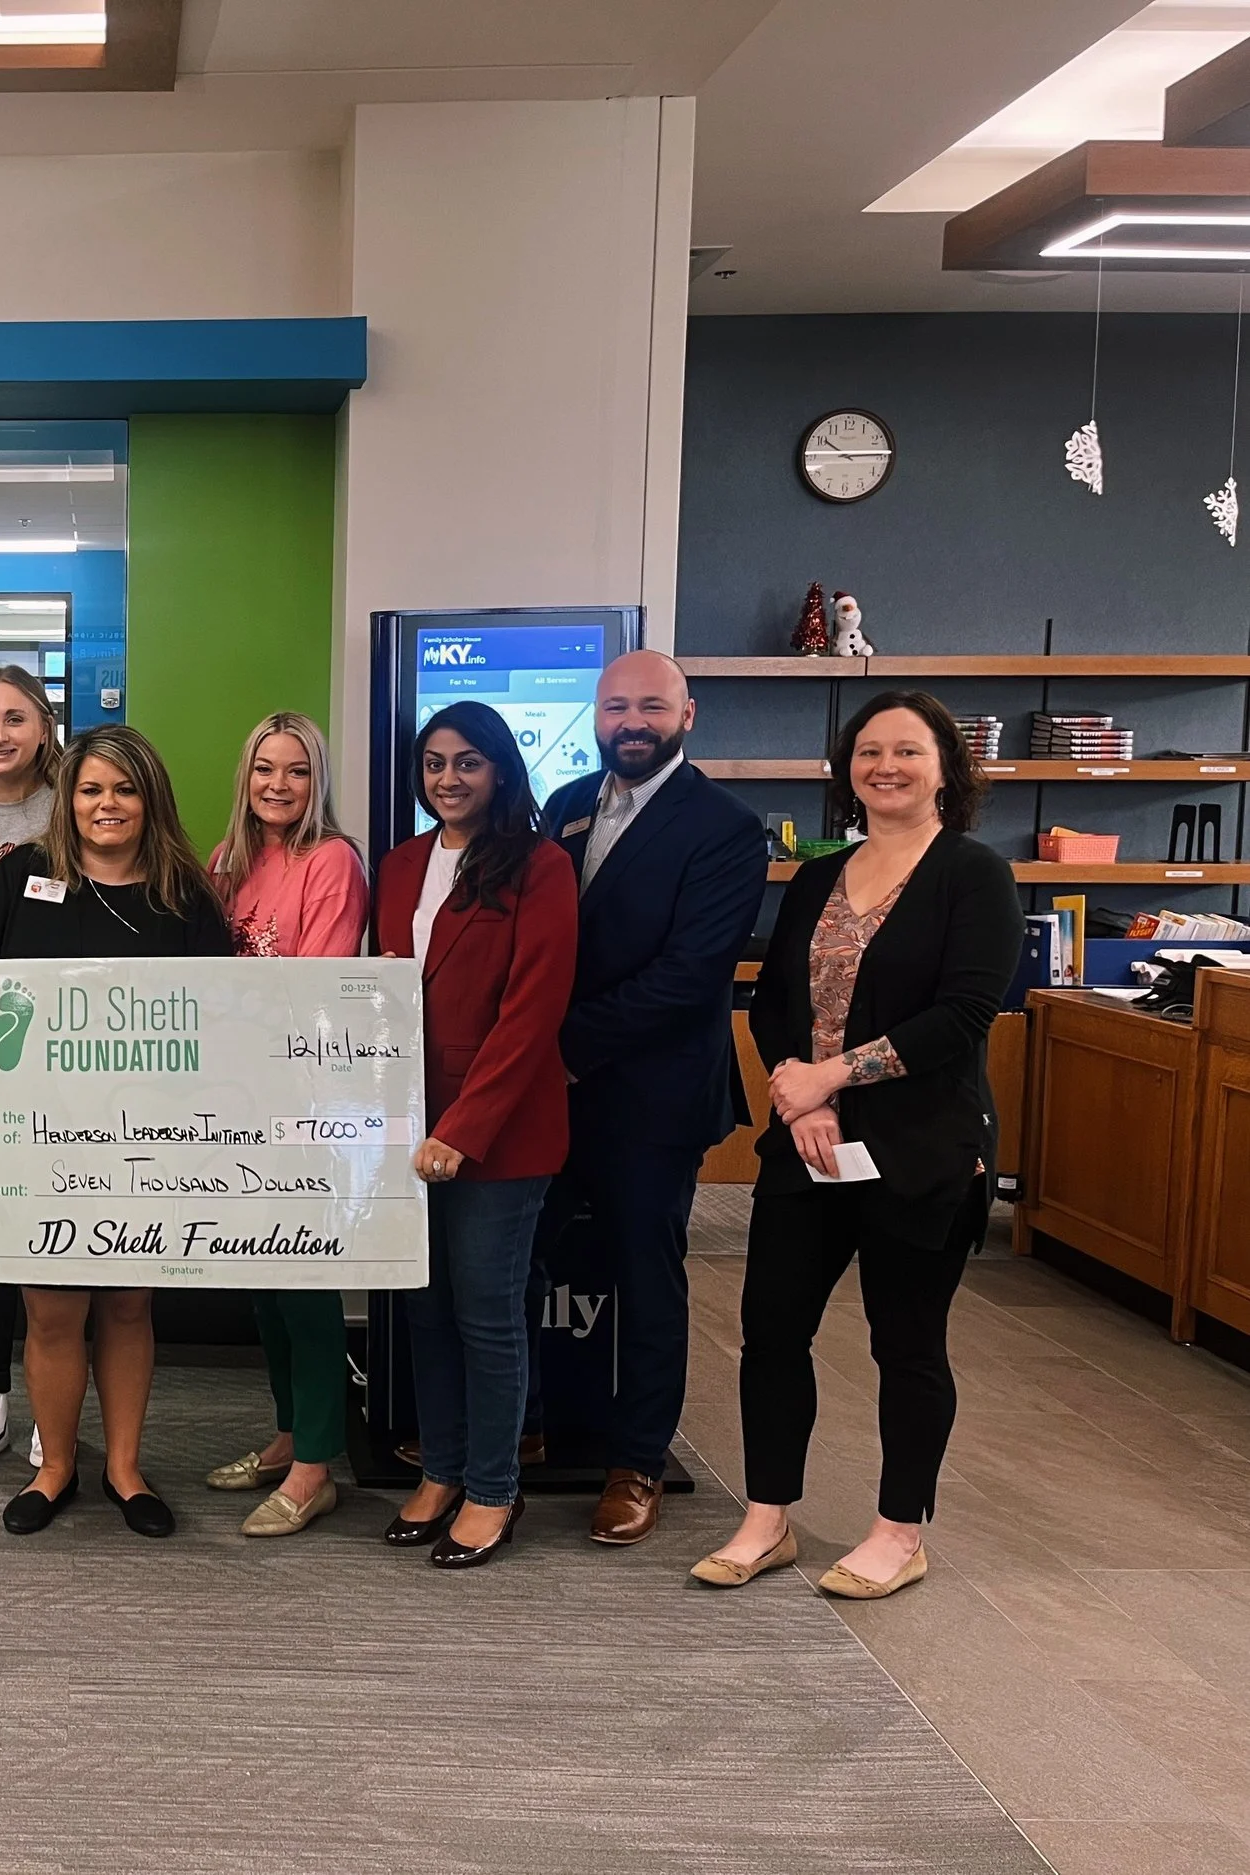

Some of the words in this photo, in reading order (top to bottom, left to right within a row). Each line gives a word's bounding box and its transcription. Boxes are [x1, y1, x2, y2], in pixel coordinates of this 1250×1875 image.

[829, 424, 838, 435] 11
[844, 419, 855, 431] 12
[817, 435, 827, 446] 10
[871, 435, 879, 445] 2
[826, 478, 833, 489] 7
[841, 482, 848, 493] 6
[857, 477, 864, 489] 5
[443, 635, 463, 643] Scholar
[47, 987, 88, 1032] JD
[106, 986, 199, 1032] Sheth
[46, 1039, 200, 1072] FOUNDATION
[330, 1063, 353, 1073] Date
[2, 1111, 25, 1124] the
[1, 1130, 22, 1144] of:
[28, 1218, 77, 1256] JD
[86, 1219, 168, 1257] Sheth
[181, 1221, 345, 1257] Foundation
[160, 1265, 204, 1276] Signature
